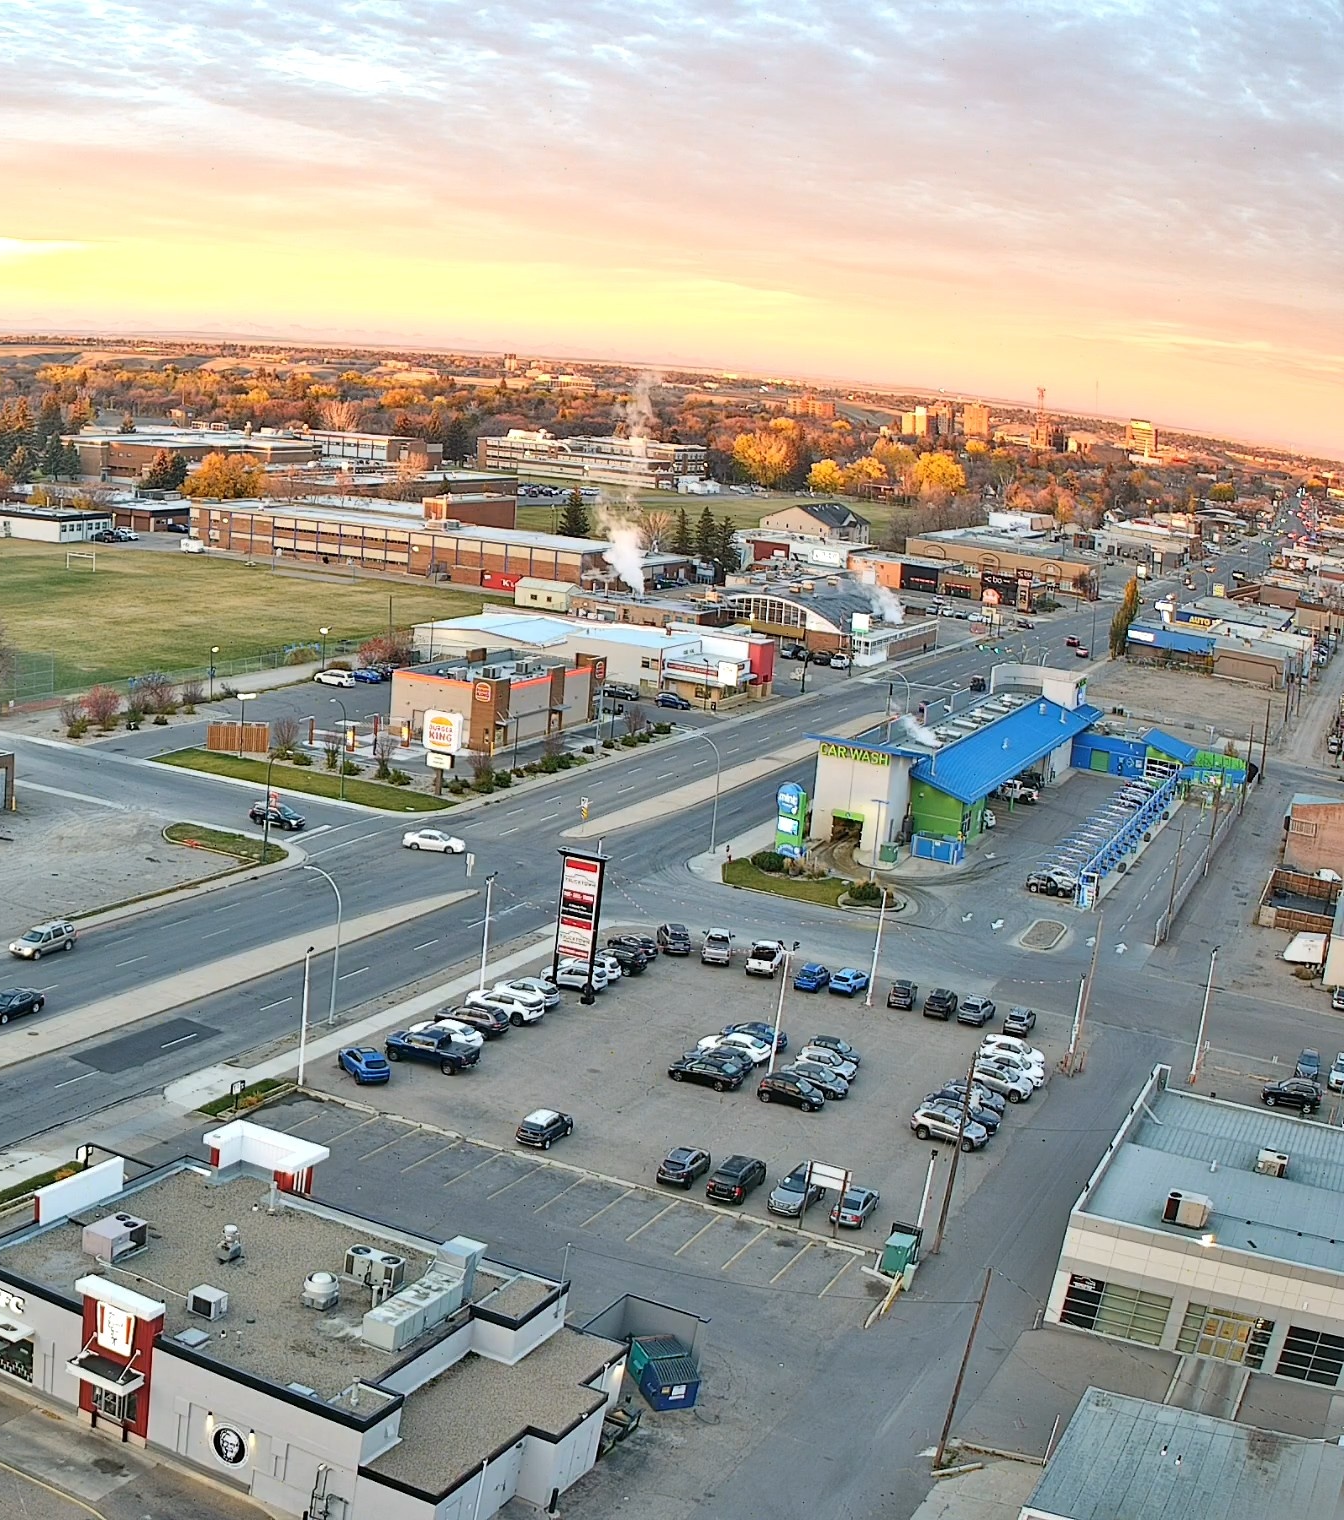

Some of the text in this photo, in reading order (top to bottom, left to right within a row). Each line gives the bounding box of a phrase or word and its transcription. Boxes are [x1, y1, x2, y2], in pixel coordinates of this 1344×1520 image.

[1189, 616, 1211, 626] AUTO
[429, 731, 453, 742] KING
[820, 742, 889, 766] CAR WASH
